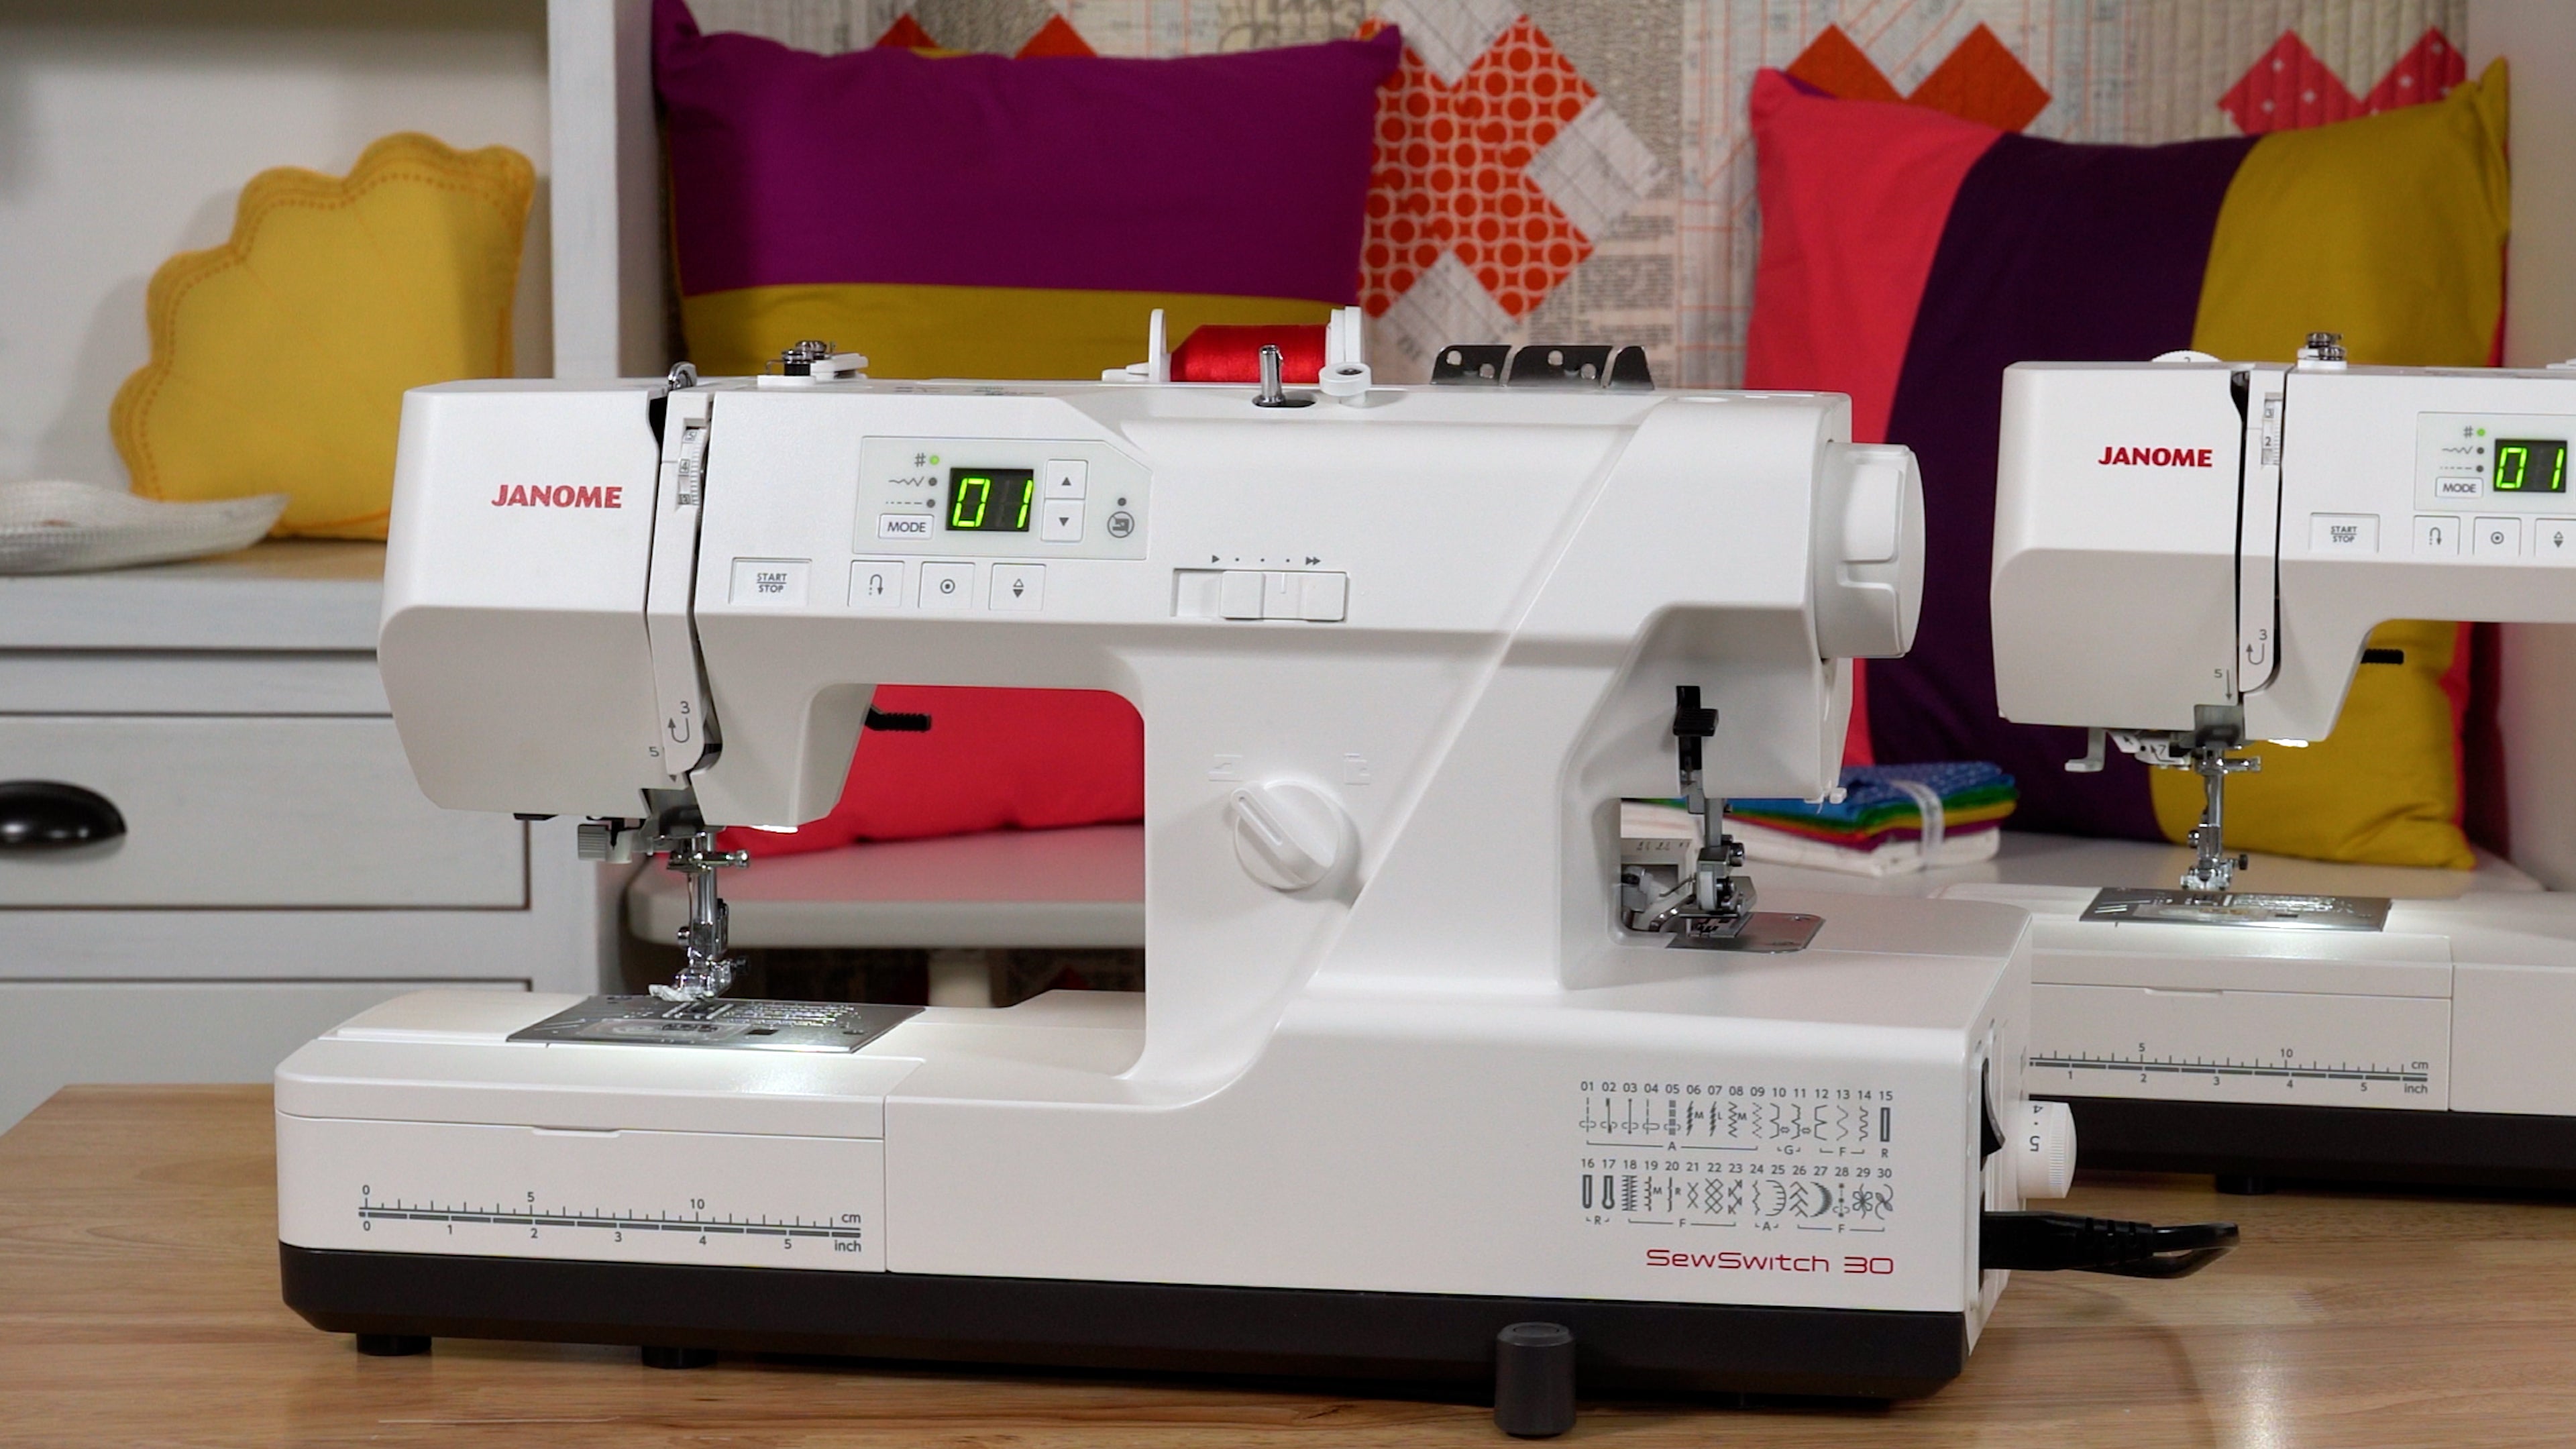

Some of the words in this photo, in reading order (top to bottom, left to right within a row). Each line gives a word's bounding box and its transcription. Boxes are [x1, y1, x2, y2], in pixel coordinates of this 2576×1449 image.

[2265, 436, 2271, 447] 2
[2098, 446, 2212, 468] JANOME
[2496, 446, 2565, 490] 01
[491, 484, 623, 509] JANOME
[2443, 483, 2476, 493] MODE
[951, 477, 1034, 529] 01
[887, 521, 926, 533] MODE
[2330, 525, 2357, 534] START
[2332, 535, 2355, 543] STOP
[757, 572, 788, 582] START
[758, 584, 784, 594] STOP
[2259, 629, 2268, 641] 3
[2214, 668, 2223, 679] 5
[680, 700, 690, 714] 3
[649, 746, 660, 757] 5
[2158, 743, 2167, 755] 7
[2139, 1042, 2146, 1053] 5
[2280, 1048, 2294, 1059] 10
[2411, 1061, 2429, 1070] cm
[2068, 1070, 2073, 1080] 1
[2140, 1073, 2147, 1083] 2
[2213, 1075, 2220, 1086] 3
[2286, 1079, 2294, 1089] 4
[2361, 1081, 2368, 1092] 5
[2404, 1083, 2428, 1094] inch
[1580, 1081, 1594, 1091] 01
[1601, 1081, 1617, 1092] 02
[1622, 1082, 1638, 1093] 03
[1644, 1083, 1659, 1093] 04
[1665, 1083, 1680, 1095] 05
[1686, 1084, 1702, 1095] 06
[1707, 1085, 1723, 1095] 07
[1728, 1085, 1744, 1097] 08
[1750, 1086, 1766, 1097] 09
[1772, 1087, 1787, 1098] 10
[1794, 1087, 1806, 1098] 11
[1815, 1088, 1829, 1099] 12
[1836, 1089, 1850, 1100] 13
[1858, 1089, 1872, 1100] 14
[1879, 1090, 1893, 1102] 15
[2033, 1105, 2043, 1114] 4
[1667, 1141, 1676, 1151] A
[1784, 1144, 1794, 1155] G
[1839, 1146, 1846, 1157] F
[1881, 1148, 1888, 1159] R
[2029, 1135, 2040, 1152] 5
[1581, 1158, 1595, 1169] 16
[1602, 1159, 1616, 1169] 17
[1623, 1159, 1638, 1170] 18
[1644, 1160, 1659, 1171] 19
[1665, 1161, 1680, 1171] 20
[1686, 1161, 1699, 1172] 21
[1707, 1162, 1722, 1173] 22
[1728, 1163, 1743, 1174] 23
[1750, 1163, 1764, 1174] 24
[1771, 1164, 1786, 1175] 25
[1792, 1165, 1807, 1176] 26
[1813, 1165, 1829, 1177] 27
[1835, 1166, 1849, 1177] 28
[1856, 1167, 1871, 1178] 29
[1877, 1167, 1892, 1179] 30
[362, 1184, 370, 1195] 0
[527, 1191, 535, 1203] 5
[690, 1198, 705, 1210] 10
[841, 1214, 861, 1224] cm
[1594, 1215, 1601, 1225] R
[1679, 1218, 1686, 1228] F
[1762, 1221, 1772, 1231] A
[1838, 1224, 1845, 1234] F
[362, 1220, 371, 1232] 0
[447, 1224, 453, 1235] 1
[531, 1227, 539, 1239] 2
[614, 1231, 623, 1242] 3
[698, 1235, 707, 1246] 4
[784, 1238, 792, 1250] 5
[834, 1239, 862, 1252] inch
[1646, 1249, 1829, 1273] SewSwitch
[1843, 1256, 1894, 1275] 30
